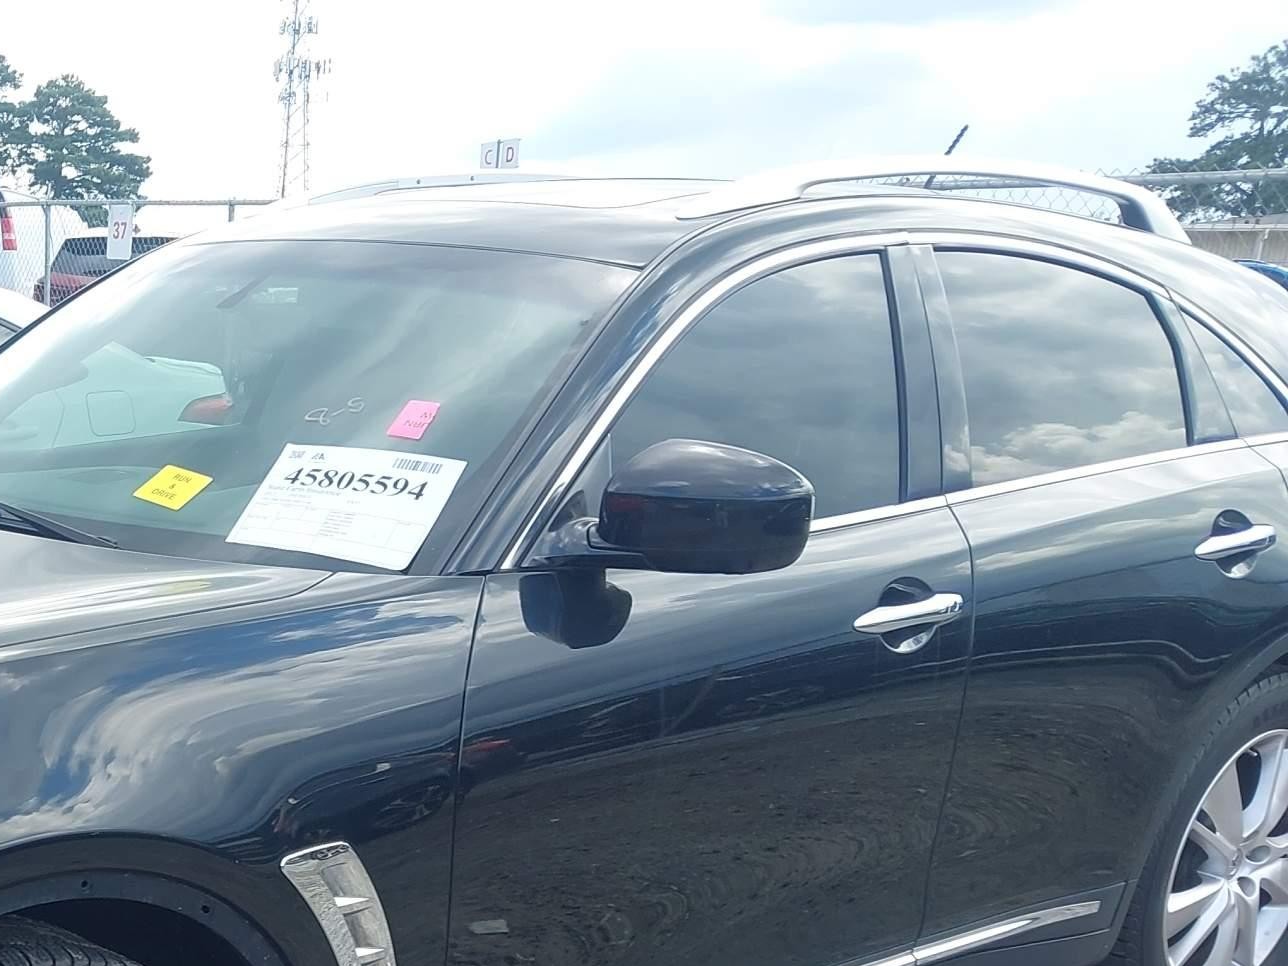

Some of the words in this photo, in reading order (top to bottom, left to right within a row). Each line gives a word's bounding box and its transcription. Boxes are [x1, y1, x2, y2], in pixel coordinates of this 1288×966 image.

[484, 149, 493, 165] C
[505, 146, 514, 163] D
[112, 220, 128, 240] 37
[172, 473, 192, 484] RUN
[284, 467, 429, 501] 45805594
[151, 488, 177, 500] DRIVE
